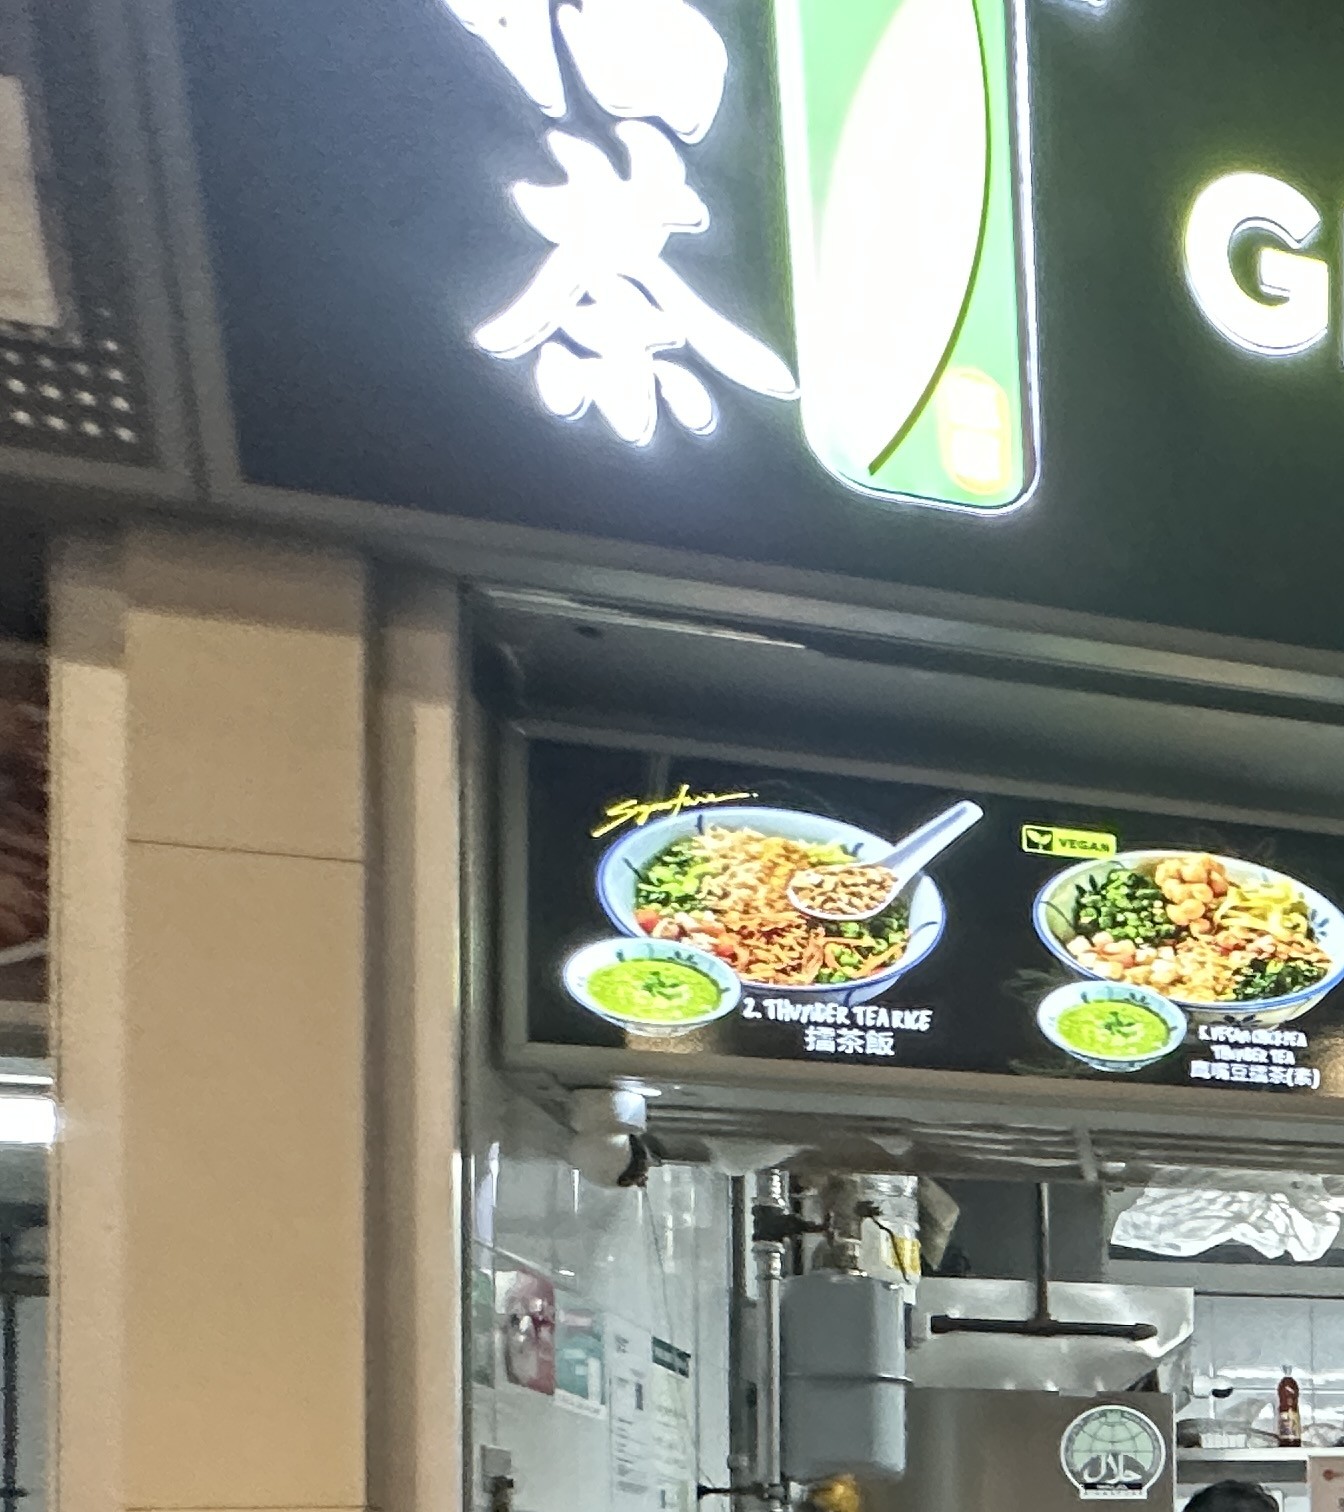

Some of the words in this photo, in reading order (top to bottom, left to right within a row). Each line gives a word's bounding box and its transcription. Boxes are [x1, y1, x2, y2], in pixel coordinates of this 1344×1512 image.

[1058, 838, 1110, 854] VEGAN
[742, 997, 762, 1020] 2.
[762, 998, 851, 1026] THUNDER
[852, 1005, 890, 1029] TEA
